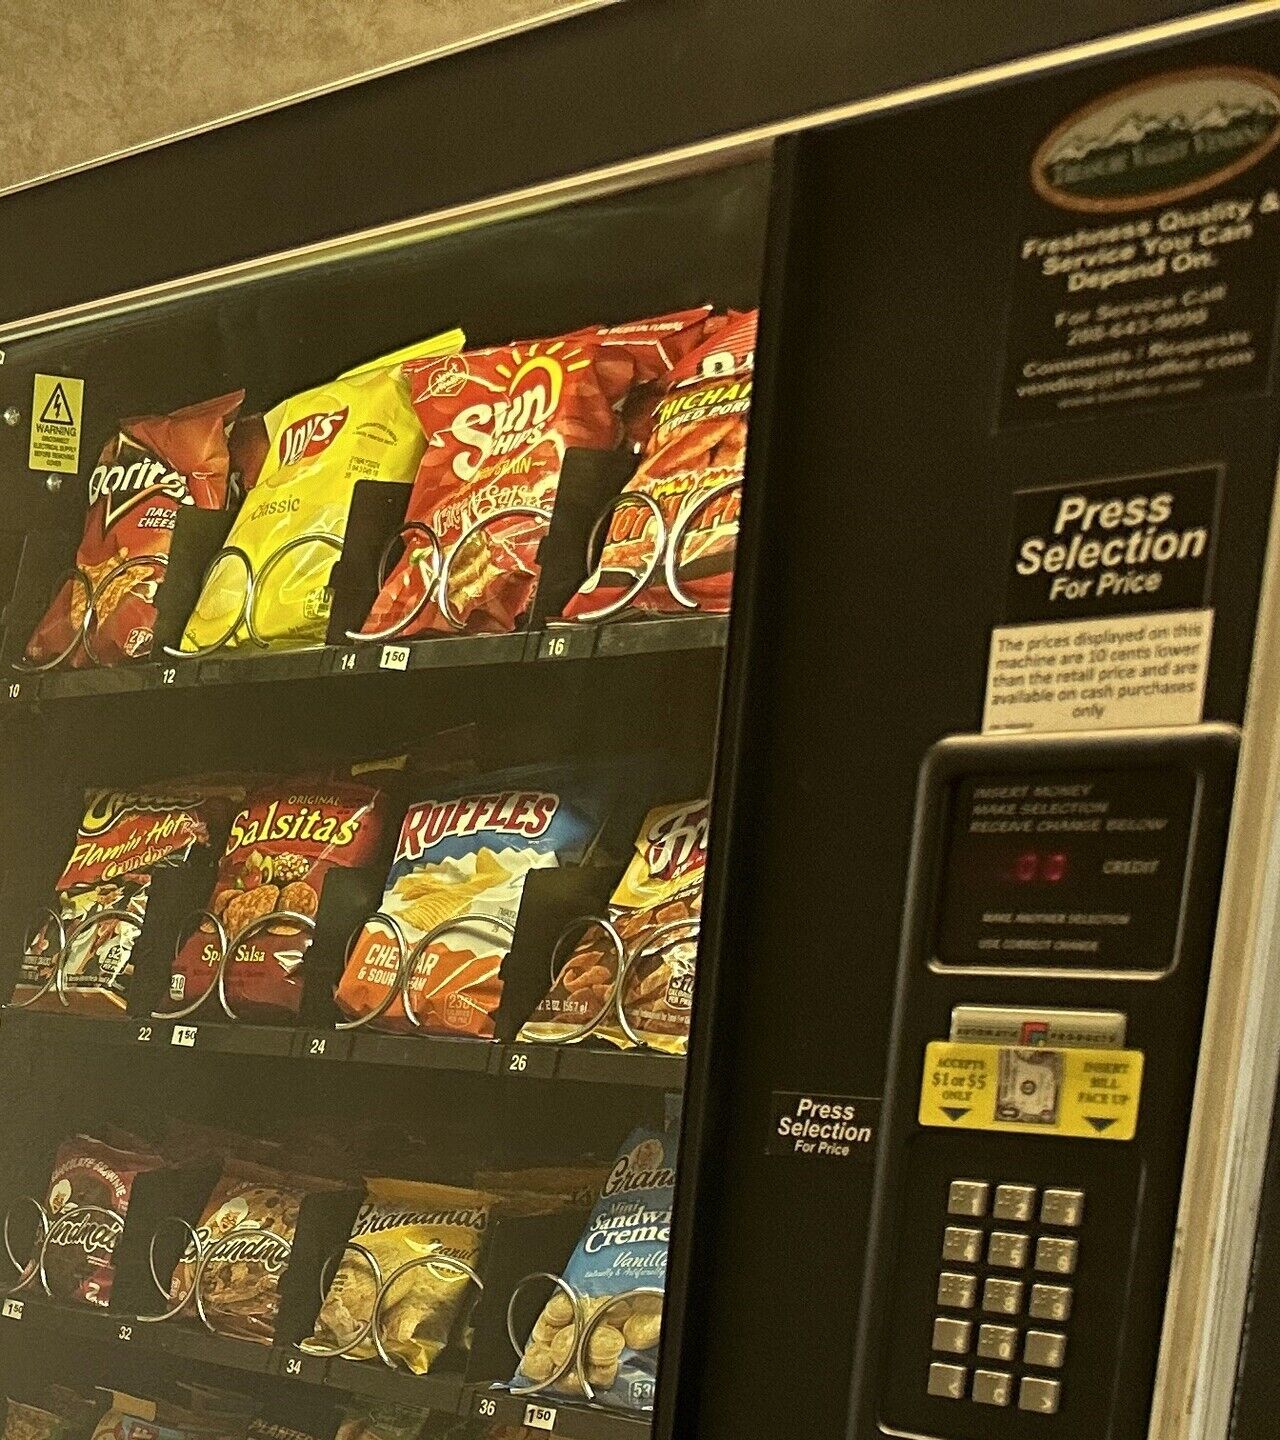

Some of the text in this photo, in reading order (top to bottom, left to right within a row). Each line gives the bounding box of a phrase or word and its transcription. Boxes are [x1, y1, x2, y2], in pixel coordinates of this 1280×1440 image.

[1157, 202, 1255, 232] Quality
[1042, 222, 1254, 276] Service You Can
[1068, 256, 1168, 293] Depend
[35, 422, 78, 437] WARNING
[282, 410, 345, 468] Lay's
[450, 382, 552, 482] Sun
[1053, 491, 1175, 536] Press
[1015, 525, 1209, 577] Selection
[1049, 570, 1163, 602] For Price
[547, 638, 565, 656] 16
[998, 639, 1024, 652] The
[1027, 635, 1071, 651] prices
[1073, 628, 1145, 647] displayed
[1148, 628, 1168, 640] on
[340, 653, 356, 670] 14
[995, 654, 1057, 670] machine
[1059, 653, 1084, 665] are
[1089, 649, 1107, 664] 10
[1109, 647, 1151, 661] cents
[162, 668, 176, 684] 12
[992, 661, 1198, 688] than the retail price and are
[8, 683, 21, 698] 10
[991, 681, 1197, 706] available on cash purchases
[1072, 703, 1105, 720] only
[288, 795, 342, 807] ORIGINAL
[1019, 802, 1109, 814] SELECTION
[146, 813, 186, 845] Hot
[225, 799, 361, 857] Salsitas
[394, 790, 561, 863] RUFFLES
[1103, 860, 1159, 875] CREDIT
[235, 944, 267, 963] Salsa
[367, 967, 398, 988] SOUR
[138, 1026, 153, 1042] 22
[310, 1038, 327, 1055] 24
[509, 1054, 528, 1072] 26
[931, 1072, 949, 1089] $1
[967, 1073, 988, 1090] $5
[941, 1091, 973, 1102] ONLY
[796, 1098, 856, 1121] Press
[777, 1117, 872, 1144] Selection
[794, 1139, 851, 1157] For Price
[118, 1326, 132, 1341] 32
[286, 1359, 302, 1375] 34
[478, 1399, 496, 1417] 36
